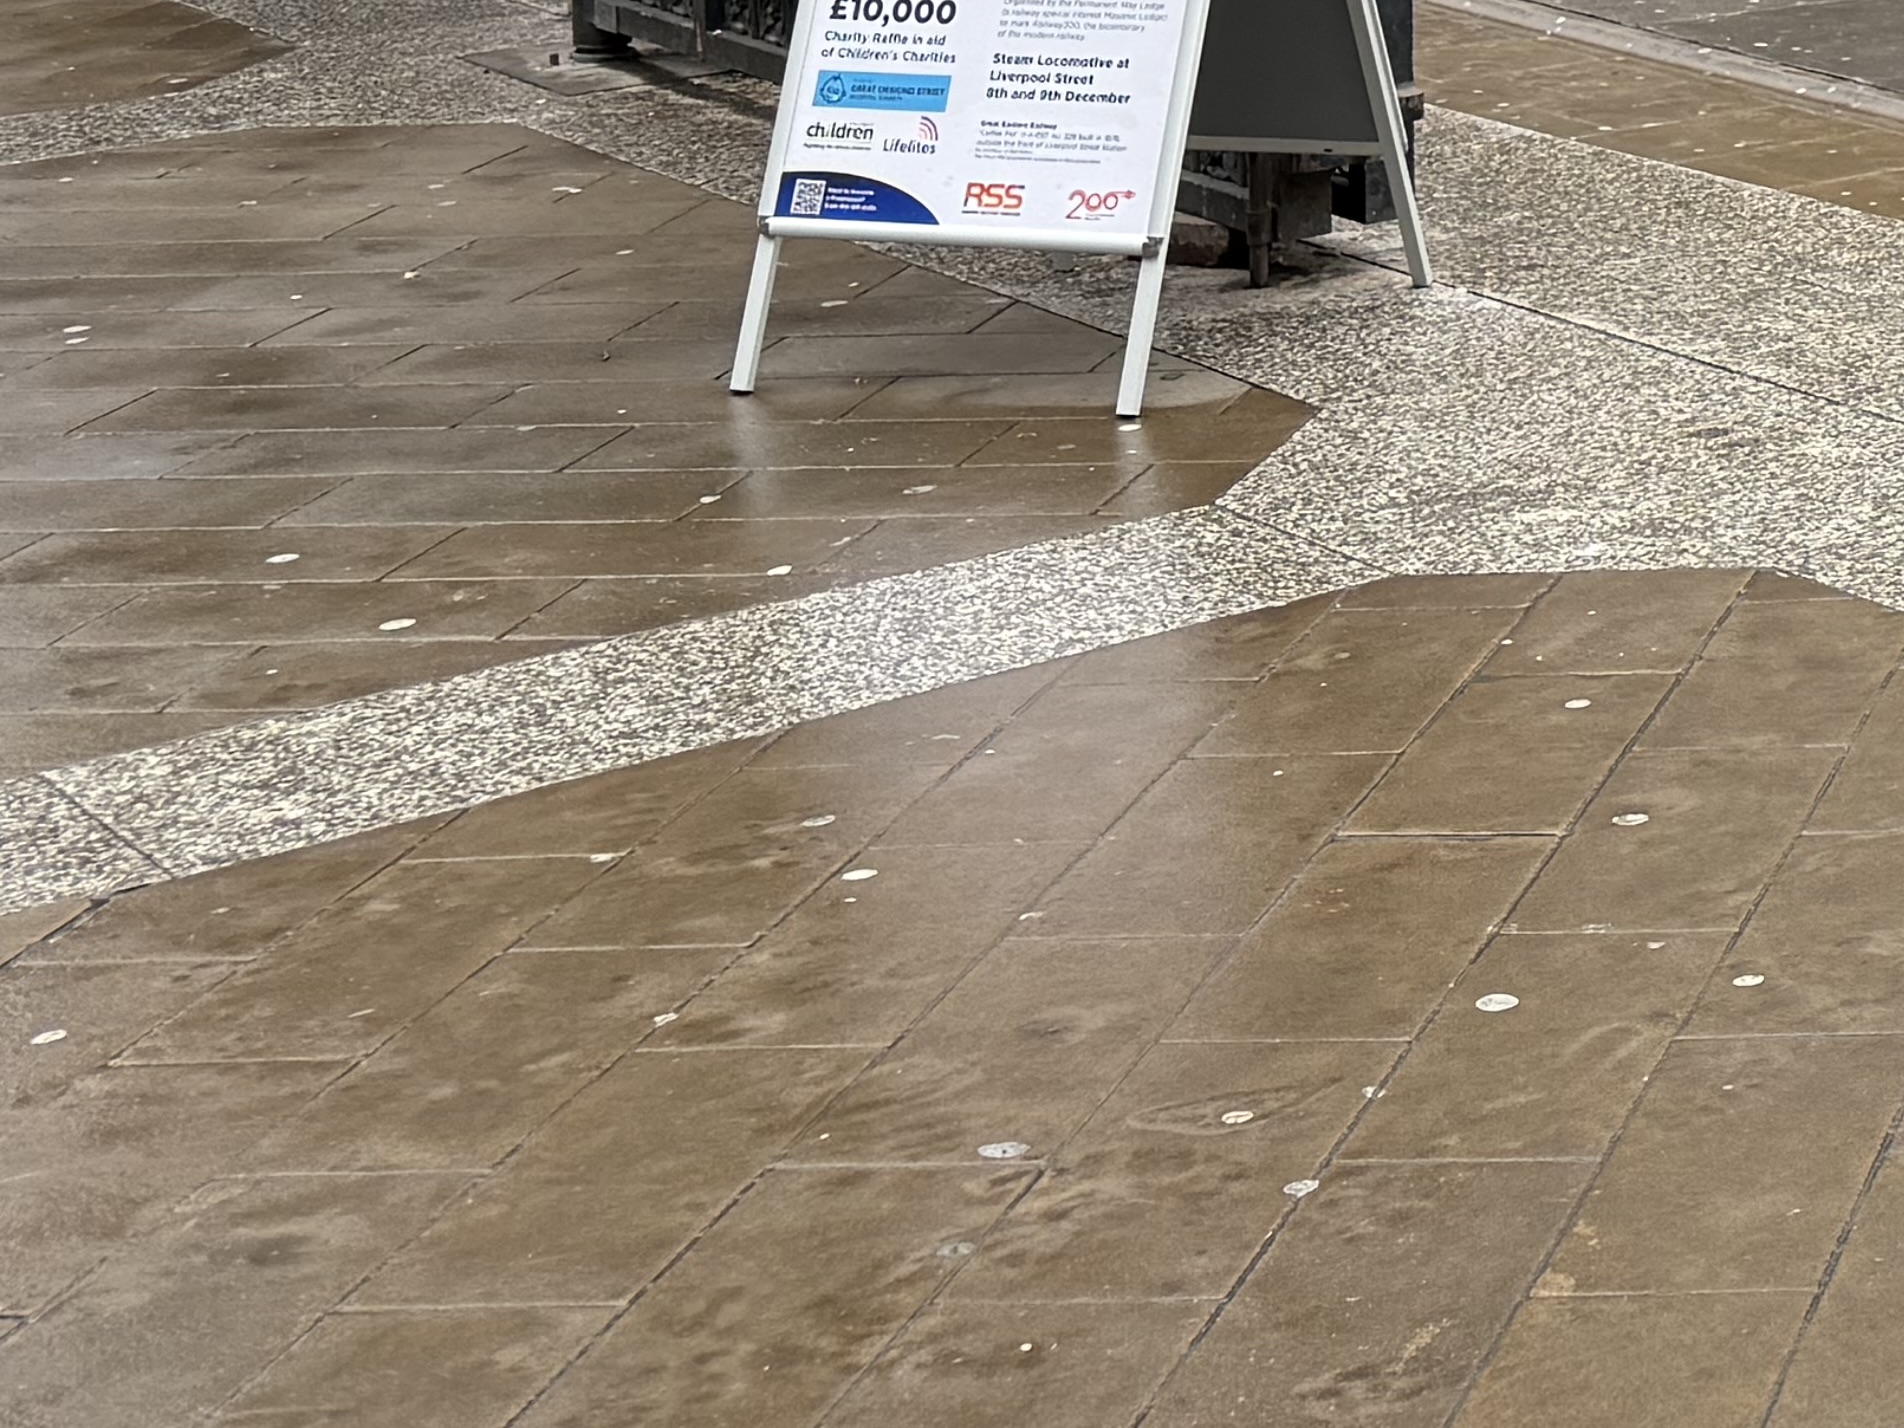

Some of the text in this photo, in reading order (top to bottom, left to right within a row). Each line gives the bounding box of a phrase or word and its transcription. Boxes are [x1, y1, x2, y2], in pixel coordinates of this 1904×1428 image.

[825, 30, 946, 46] Charity Raffle in aid
[821, 47, 956, 63] of Children's Charities
[993, 53, 1129, 68] Steam Locomotive at
[990, 70, 1094, 85] Liverpool Street
[986, 87, 1130, 104] 8th and 9th December
[806, 121, 874, 140] children
[963, 182, 1025, 209] RSS
[1066, 189, 1118, 220] 200
